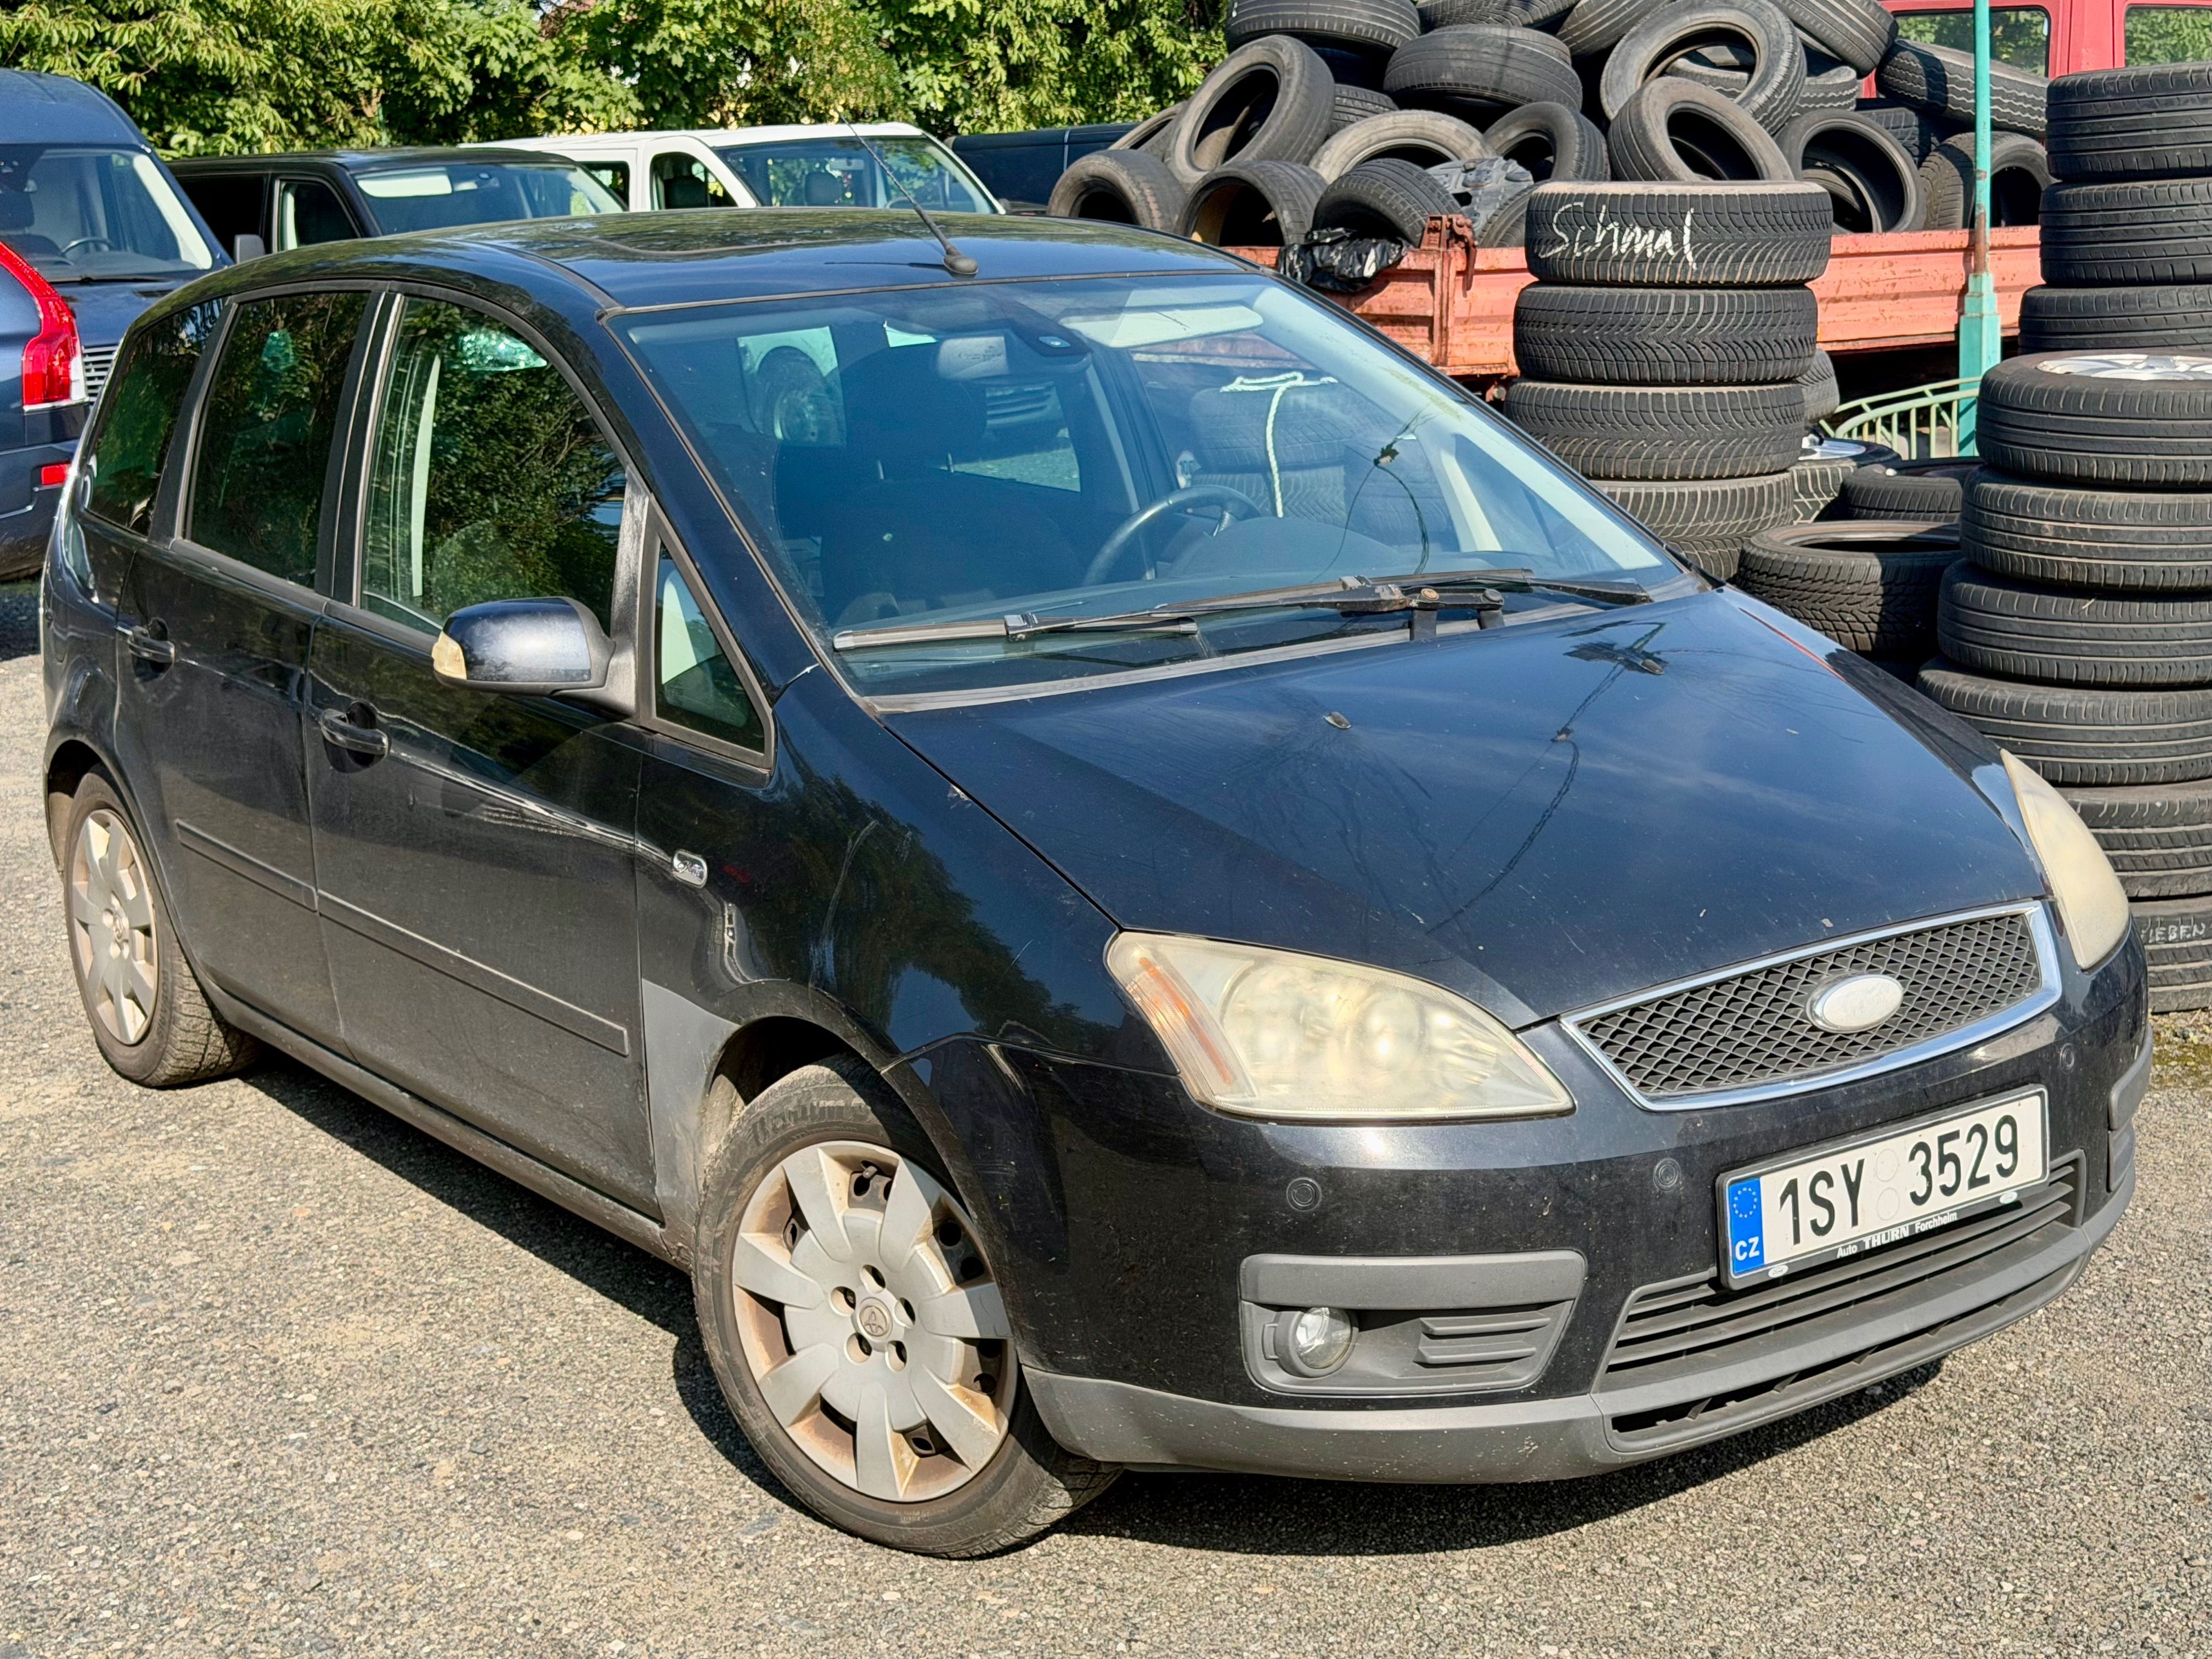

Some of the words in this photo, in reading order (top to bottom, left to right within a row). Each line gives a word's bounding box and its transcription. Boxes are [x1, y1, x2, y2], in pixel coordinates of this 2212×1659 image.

[1779, 1158, 1865, 1246] 1SY
[1908, 1114, 2018, 1206] 3529
[1735, 1235, 1760, 1261] CZ
[1837, 1244, 1858, 1259] Auto
[1863, 1224, 1910, 1249] THURN
[1915, 1211, 1958, 1234] Forchheim
